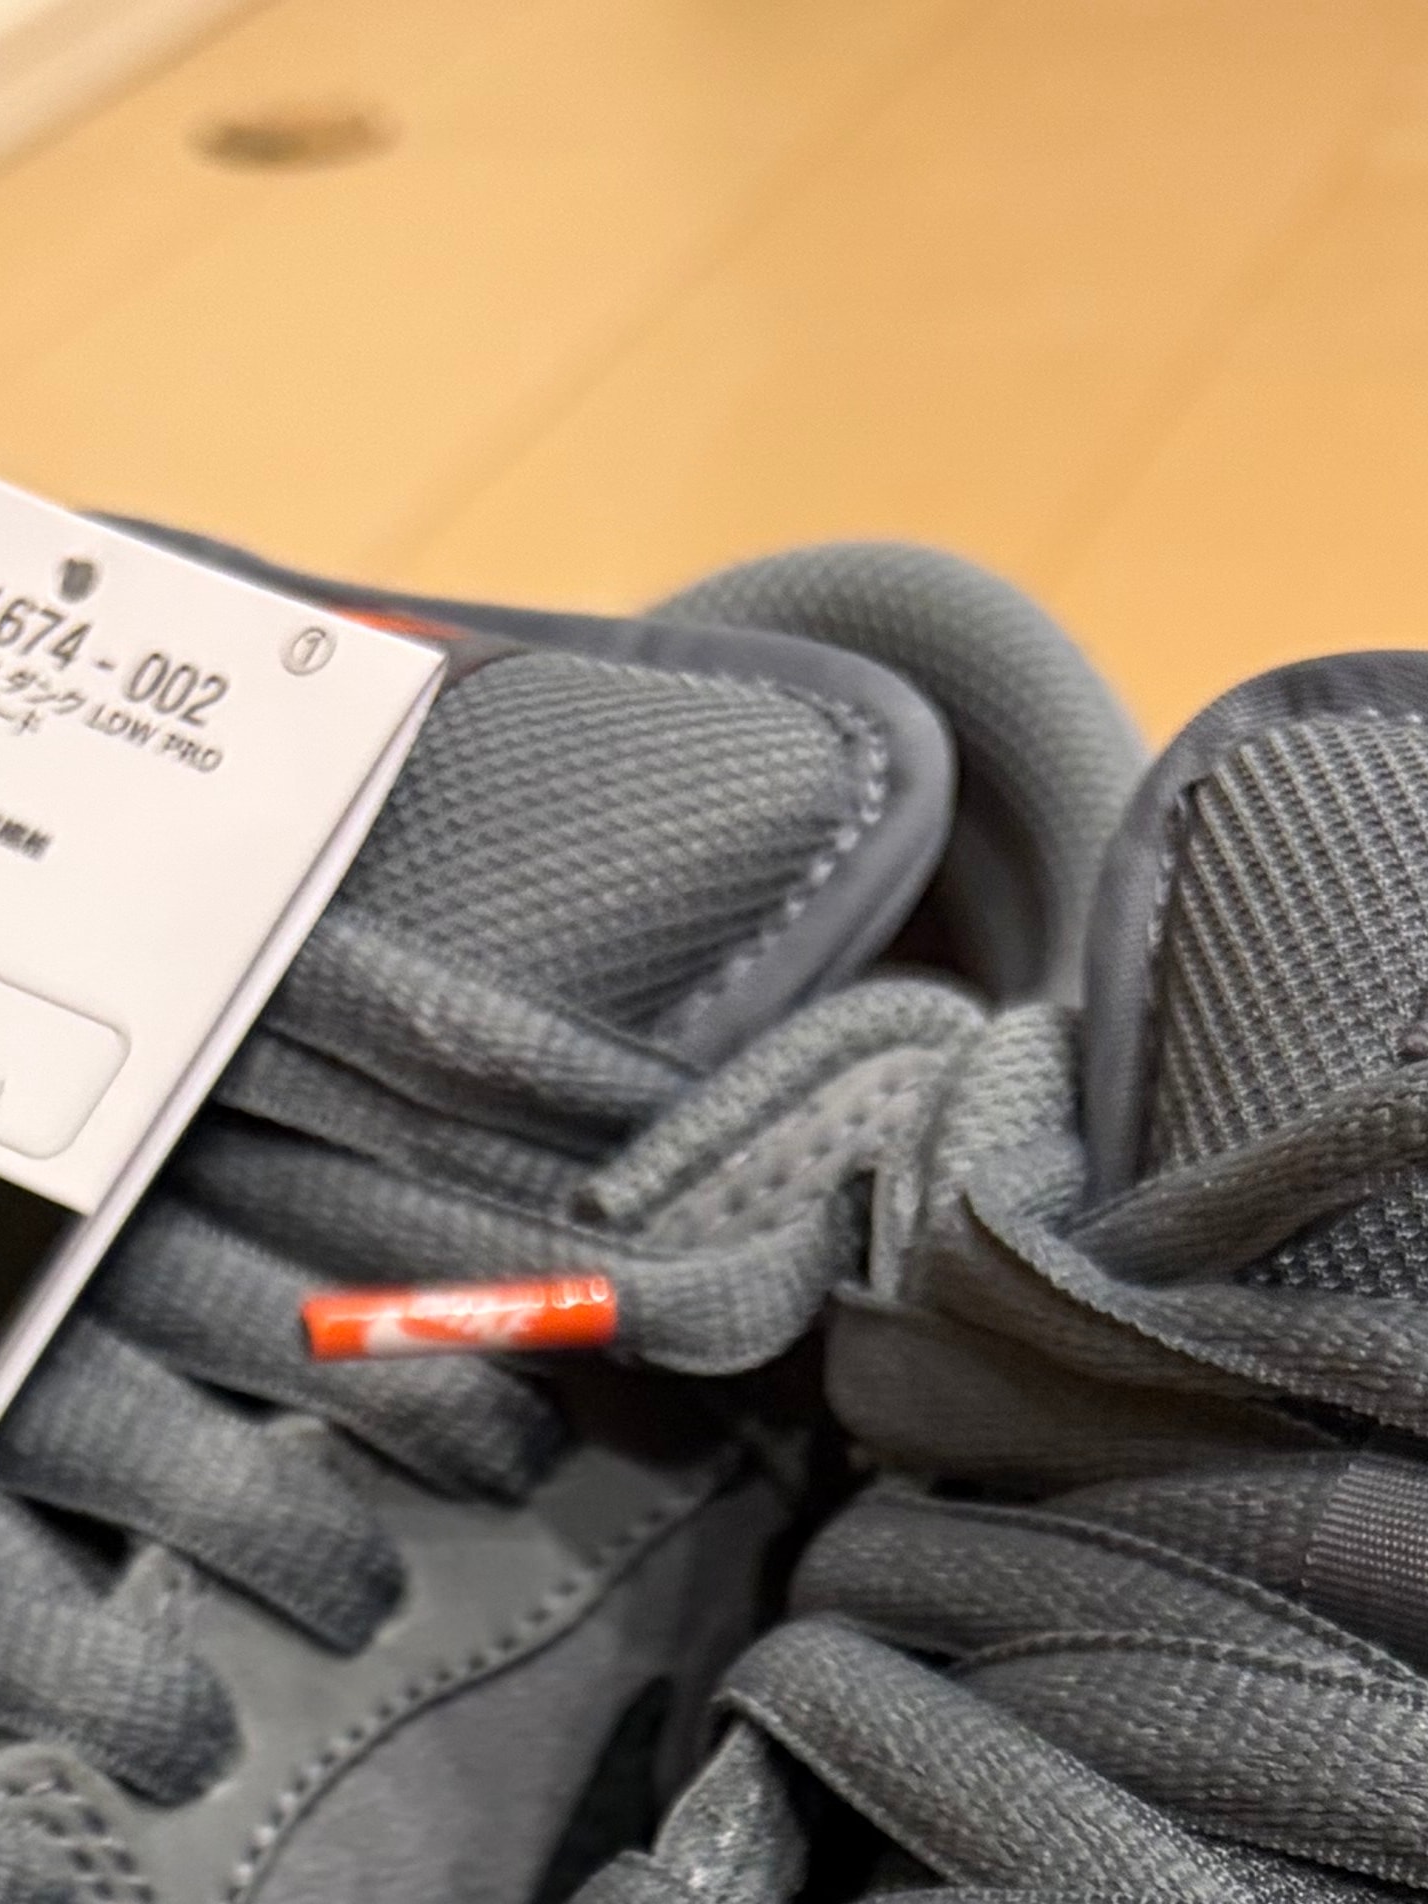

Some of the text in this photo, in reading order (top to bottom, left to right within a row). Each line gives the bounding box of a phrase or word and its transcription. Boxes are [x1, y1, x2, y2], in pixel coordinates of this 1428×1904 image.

[120, 645, 233, 734] 002
[83, 700, 160, 753] LOW
[156, 729, 226, 777] PRO
